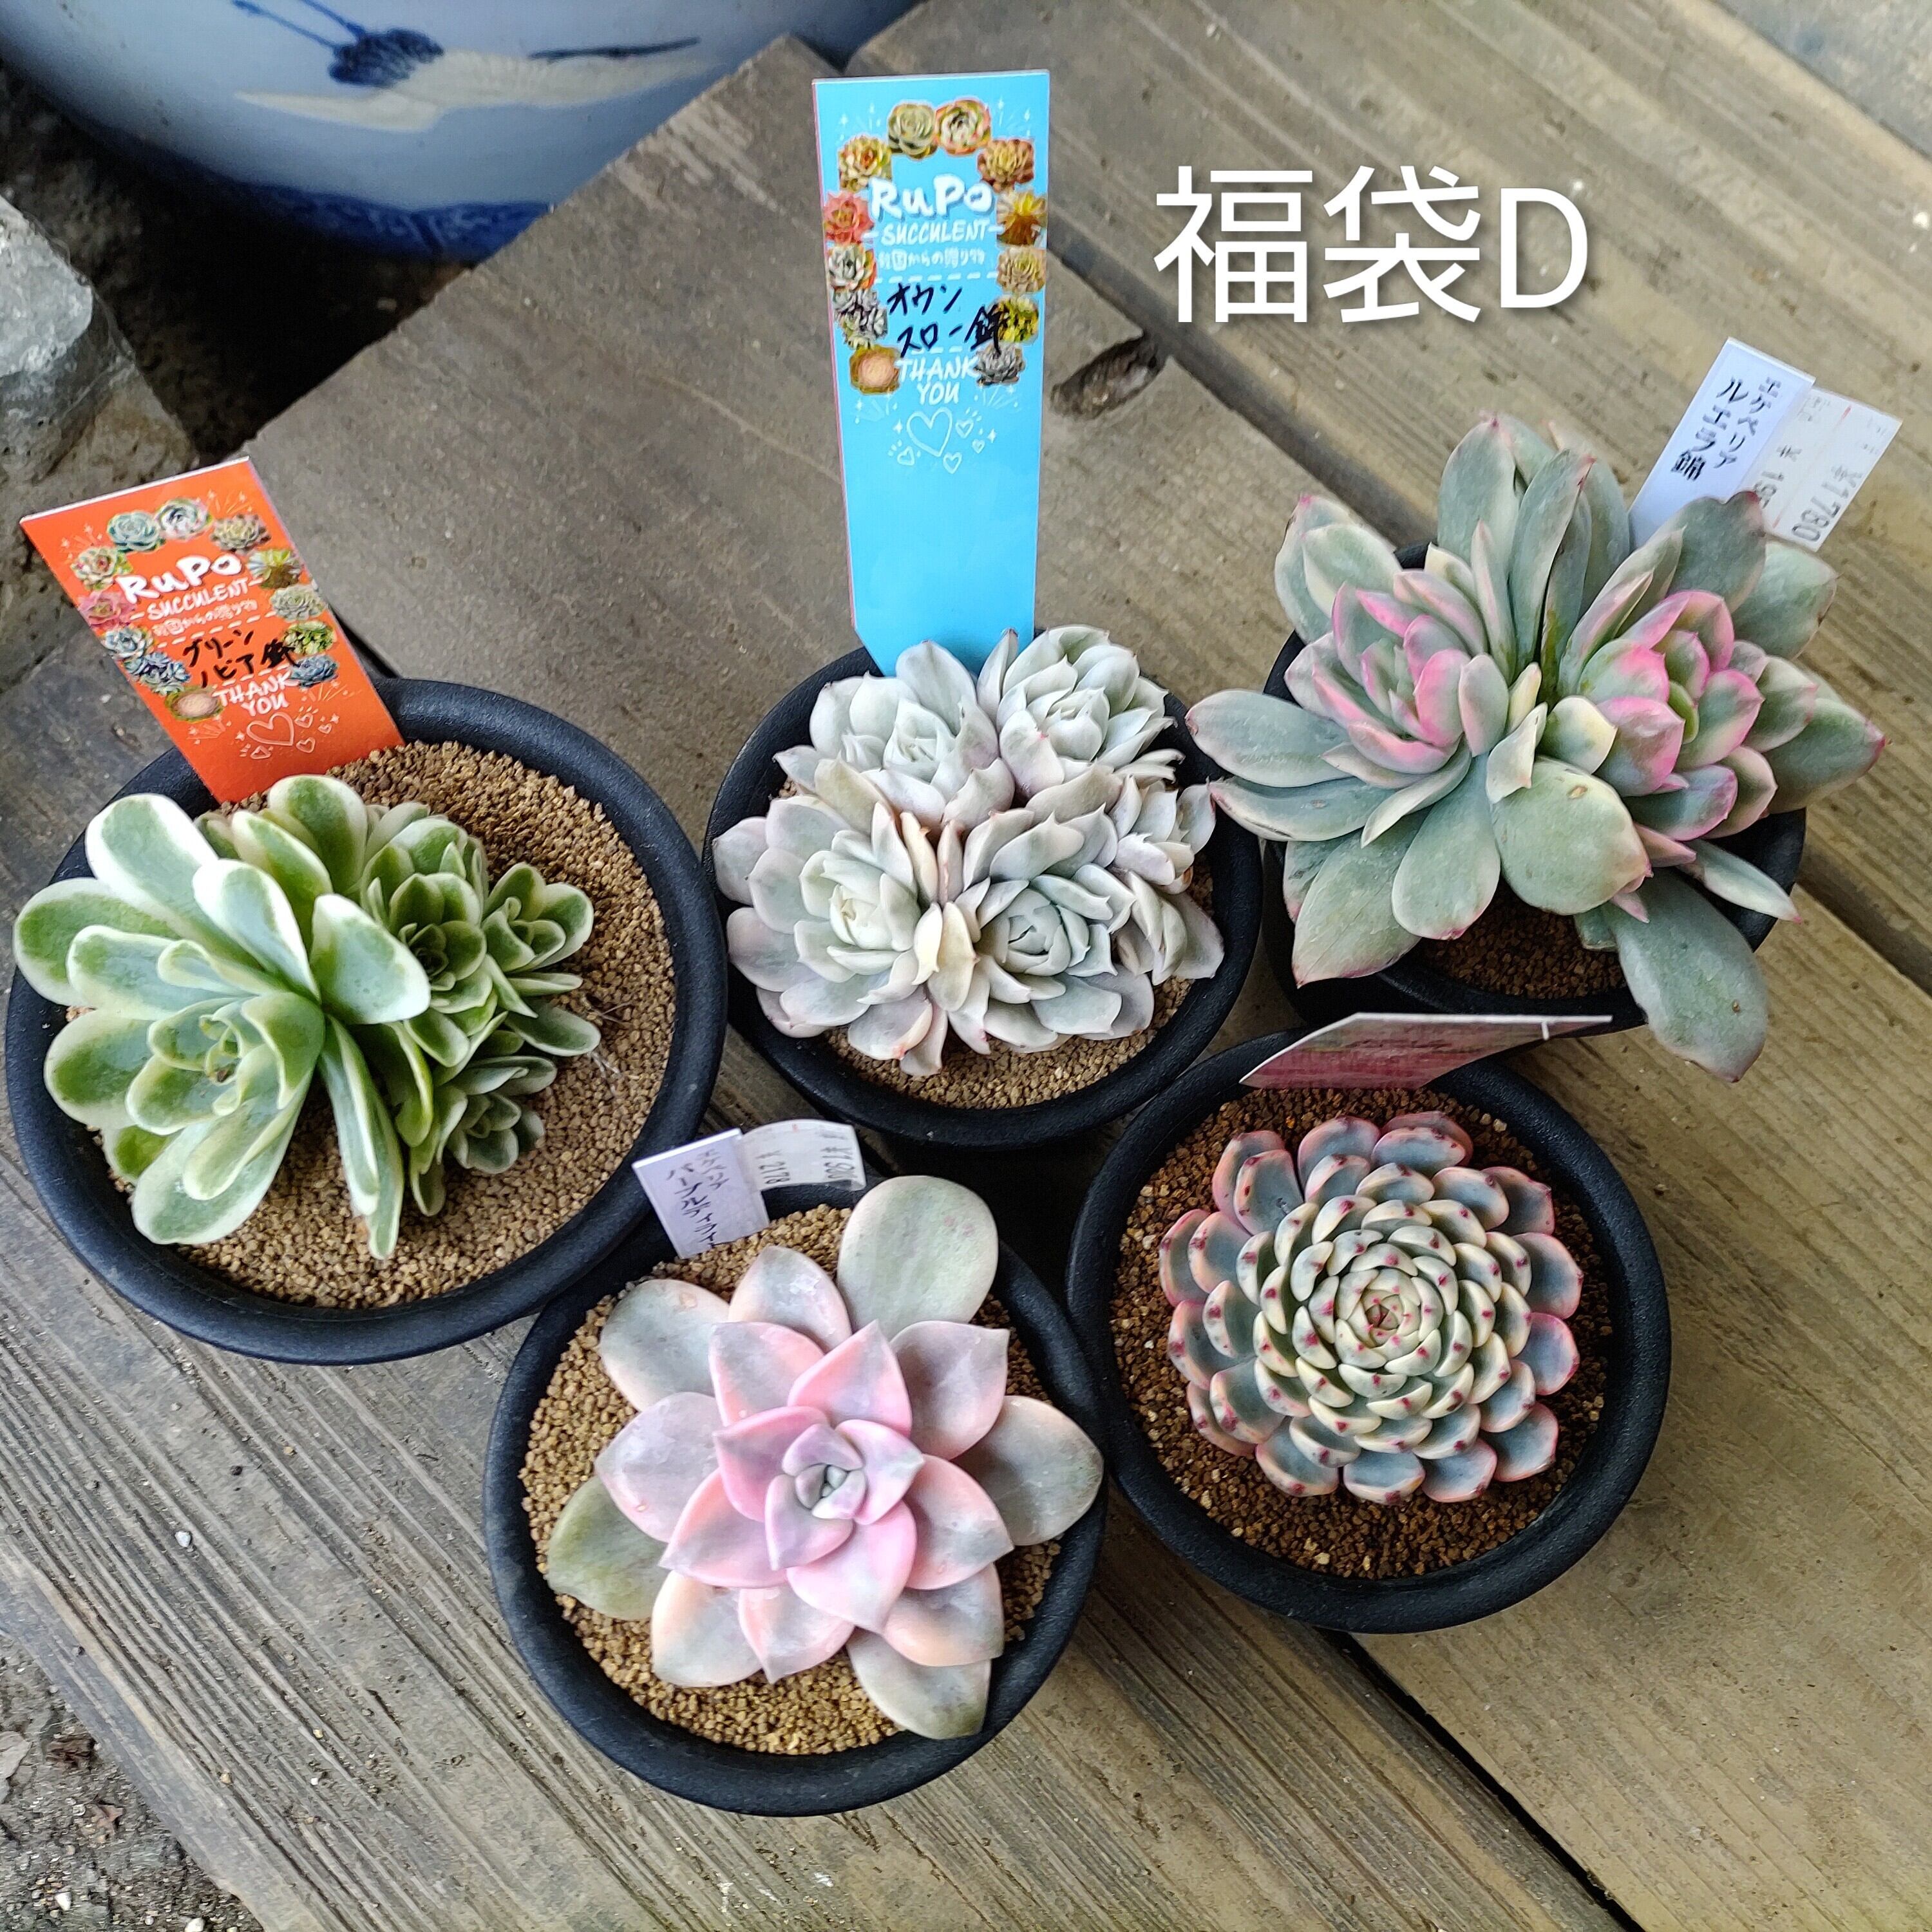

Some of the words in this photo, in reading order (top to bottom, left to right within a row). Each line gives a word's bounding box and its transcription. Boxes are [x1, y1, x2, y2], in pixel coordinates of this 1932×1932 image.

[881, 218, 989, 245] SUCCULENT
[896, 356, 979, 382] THANK
[917, 382, 960, 405] YOU
[147, 578, 249, 620] SUCCULENT
[213, 671, 299, 706] THANK
[242, 693, 289, 716] YOU
